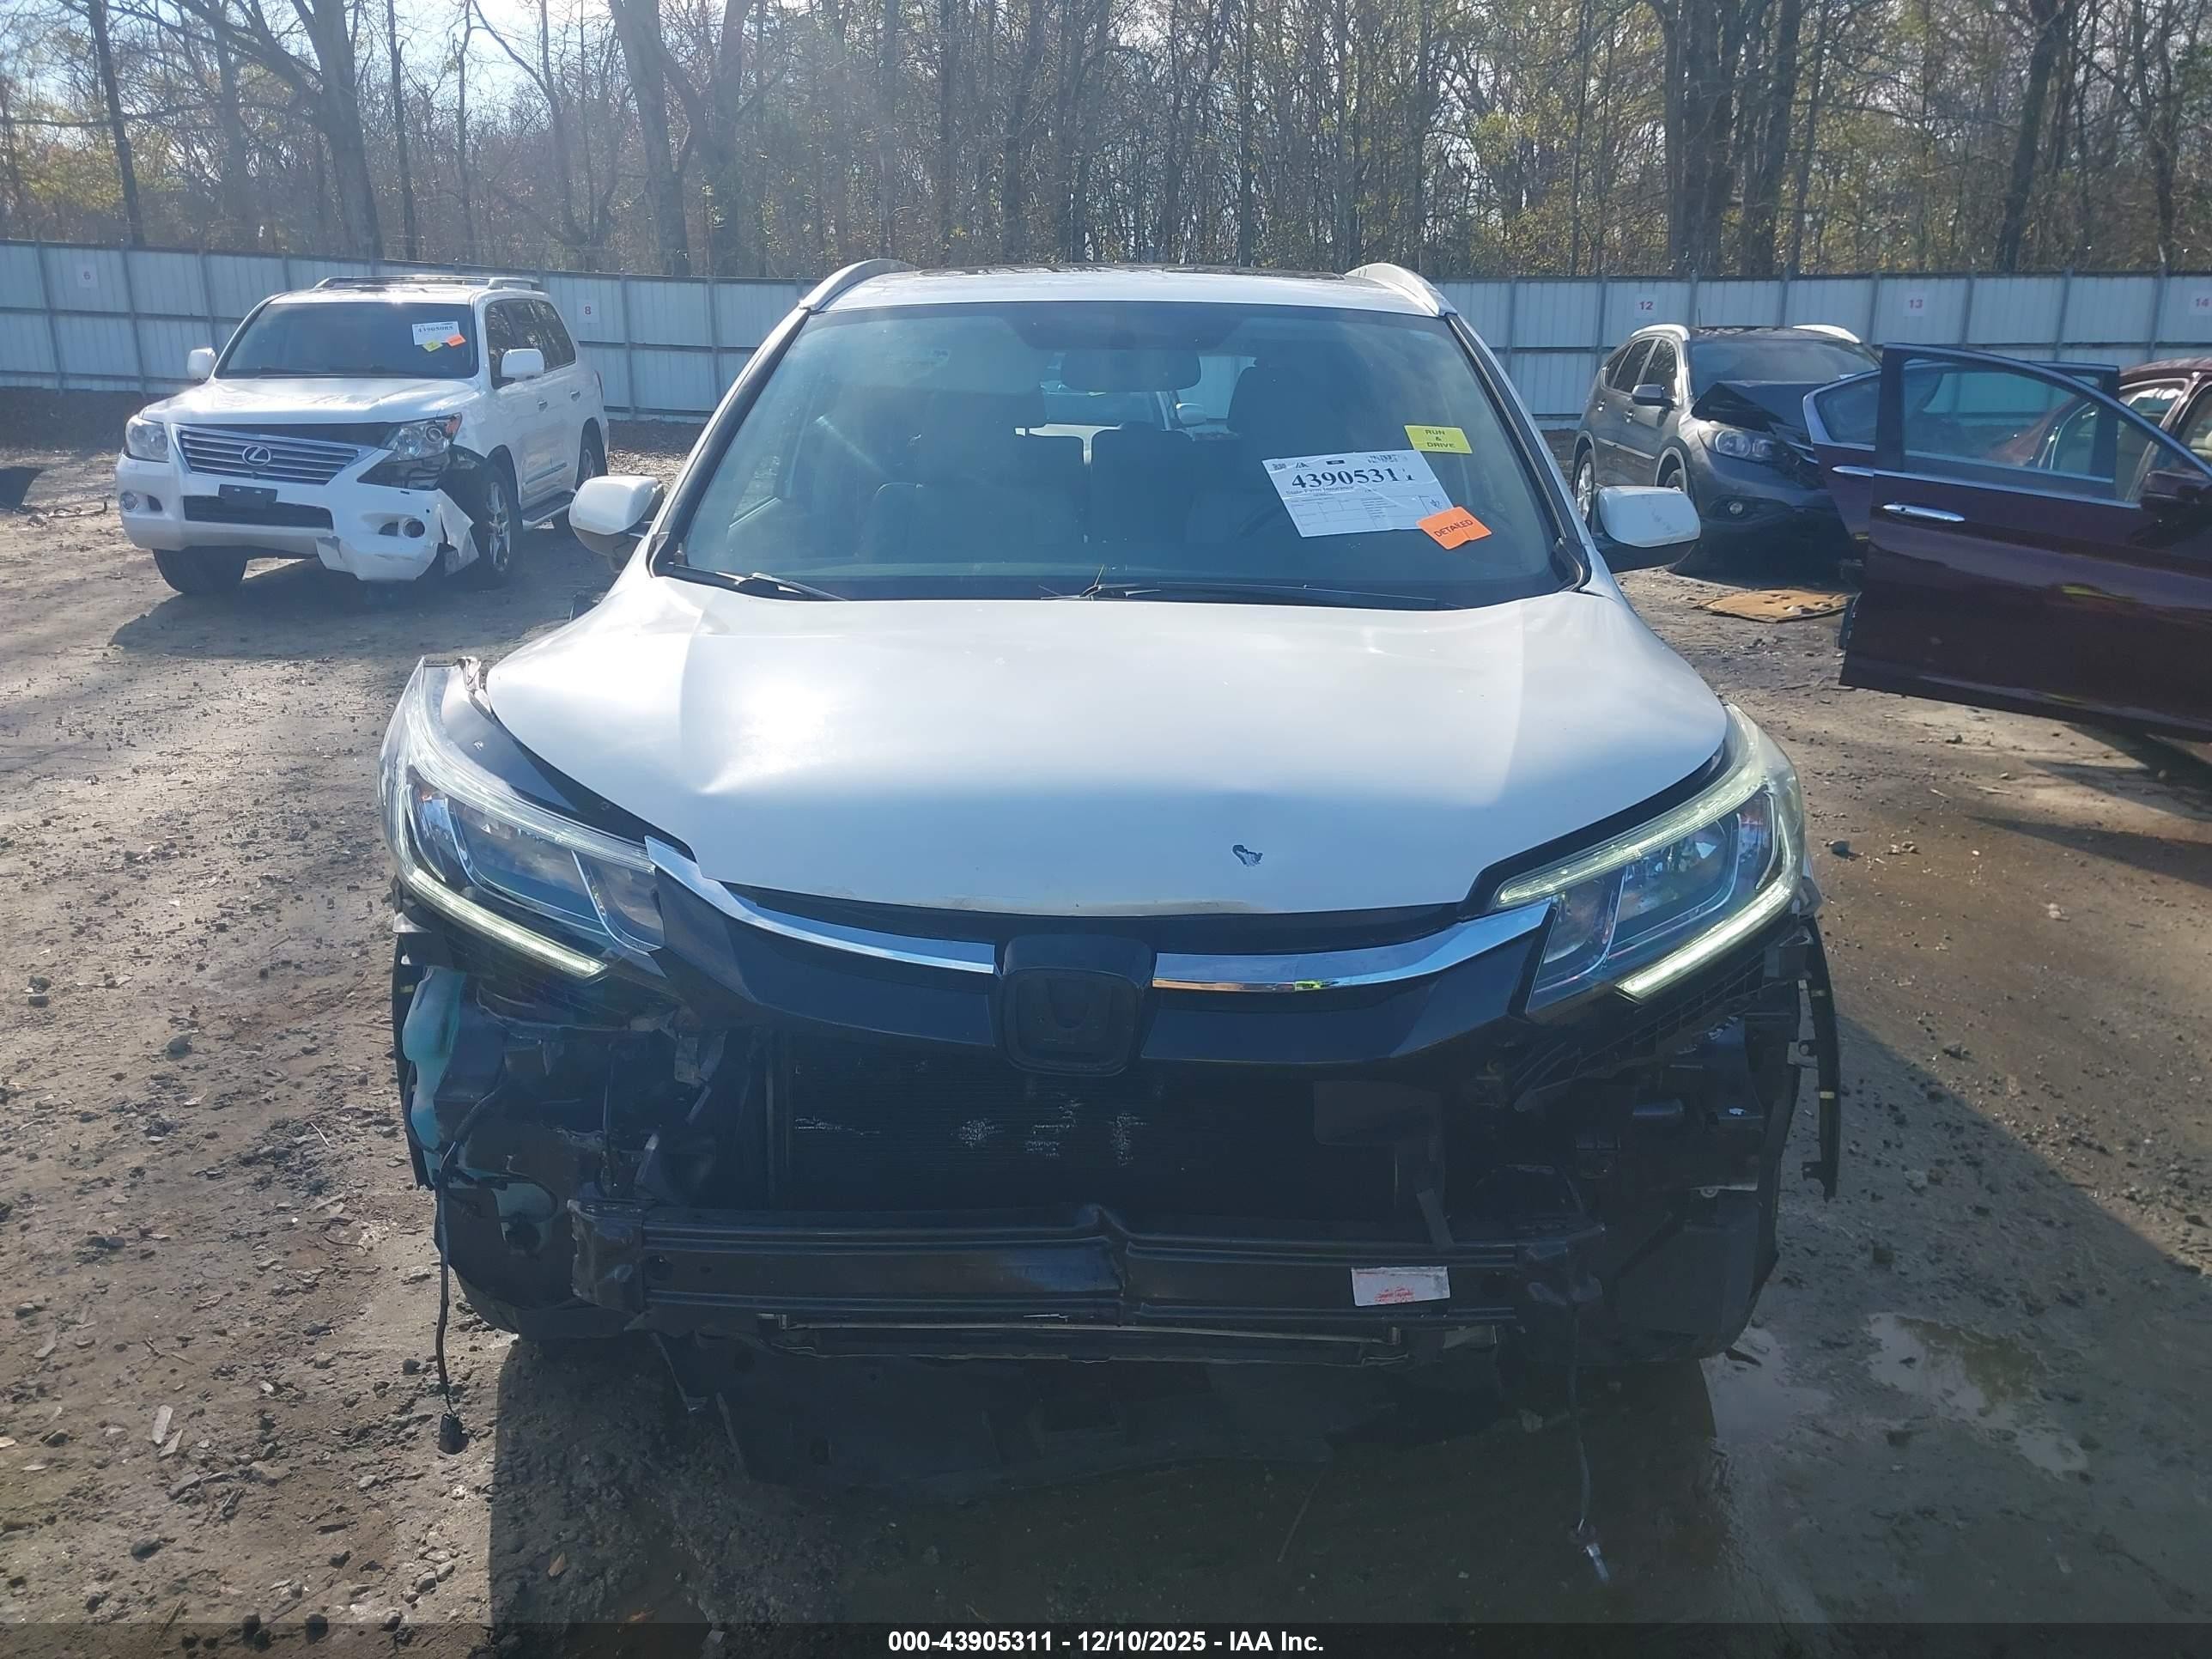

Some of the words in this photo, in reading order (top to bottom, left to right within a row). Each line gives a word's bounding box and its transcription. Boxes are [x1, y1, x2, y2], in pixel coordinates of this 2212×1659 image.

[1639, 301, 1654, 310] 12
[1909, 299, 1923, 309] 13
[2196, 298, 2209, 307] 14
[584, 306, 592, 315] 8
[1434, 519, 1474, 538] DETAILED
